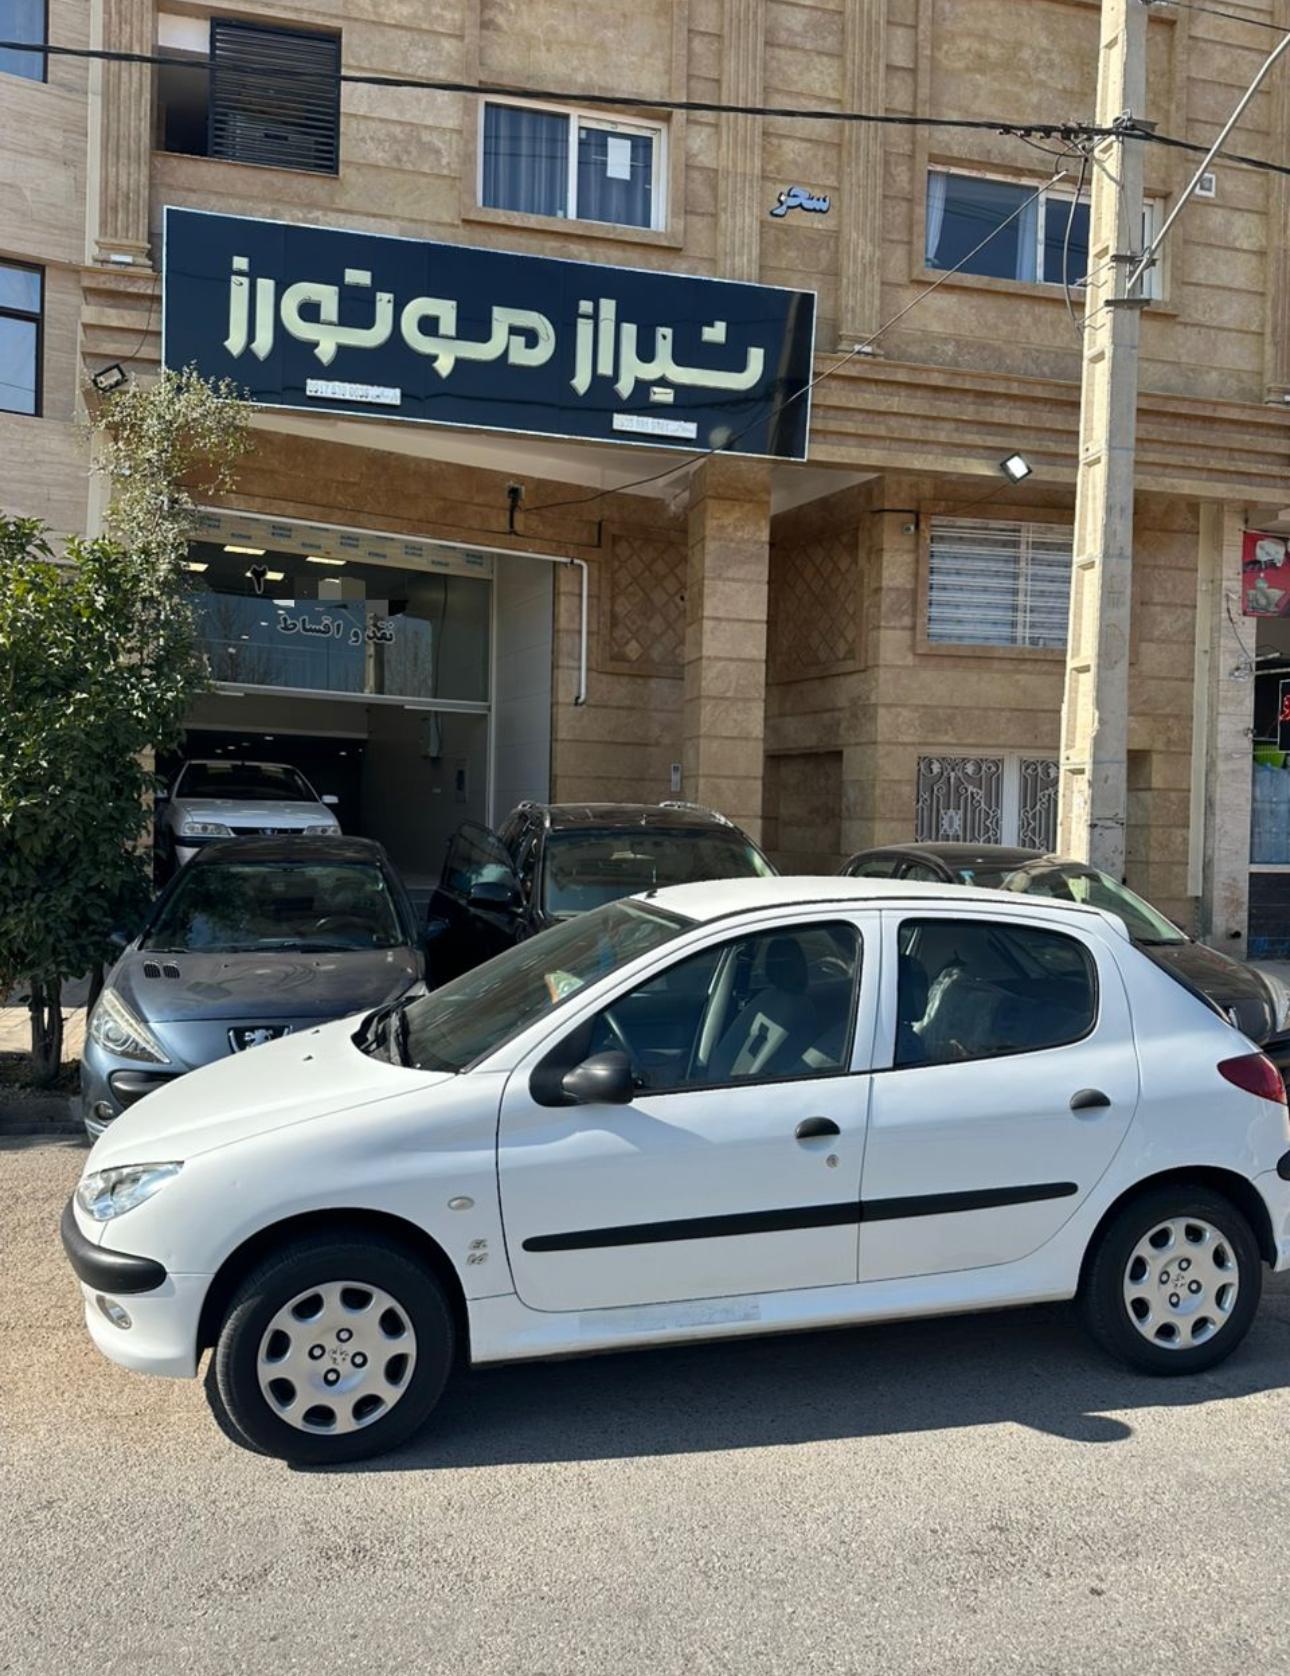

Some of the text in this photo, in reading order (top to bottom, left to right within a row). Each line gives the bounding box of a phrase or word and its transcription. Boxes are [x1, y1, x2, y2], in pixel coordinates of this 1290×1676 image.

[770, 186, 830, 217] سحر
[570, 298, 765, 404] شیراز
[277, 615, 344, 638] اقساط
[348, 628, 362, 645] و
